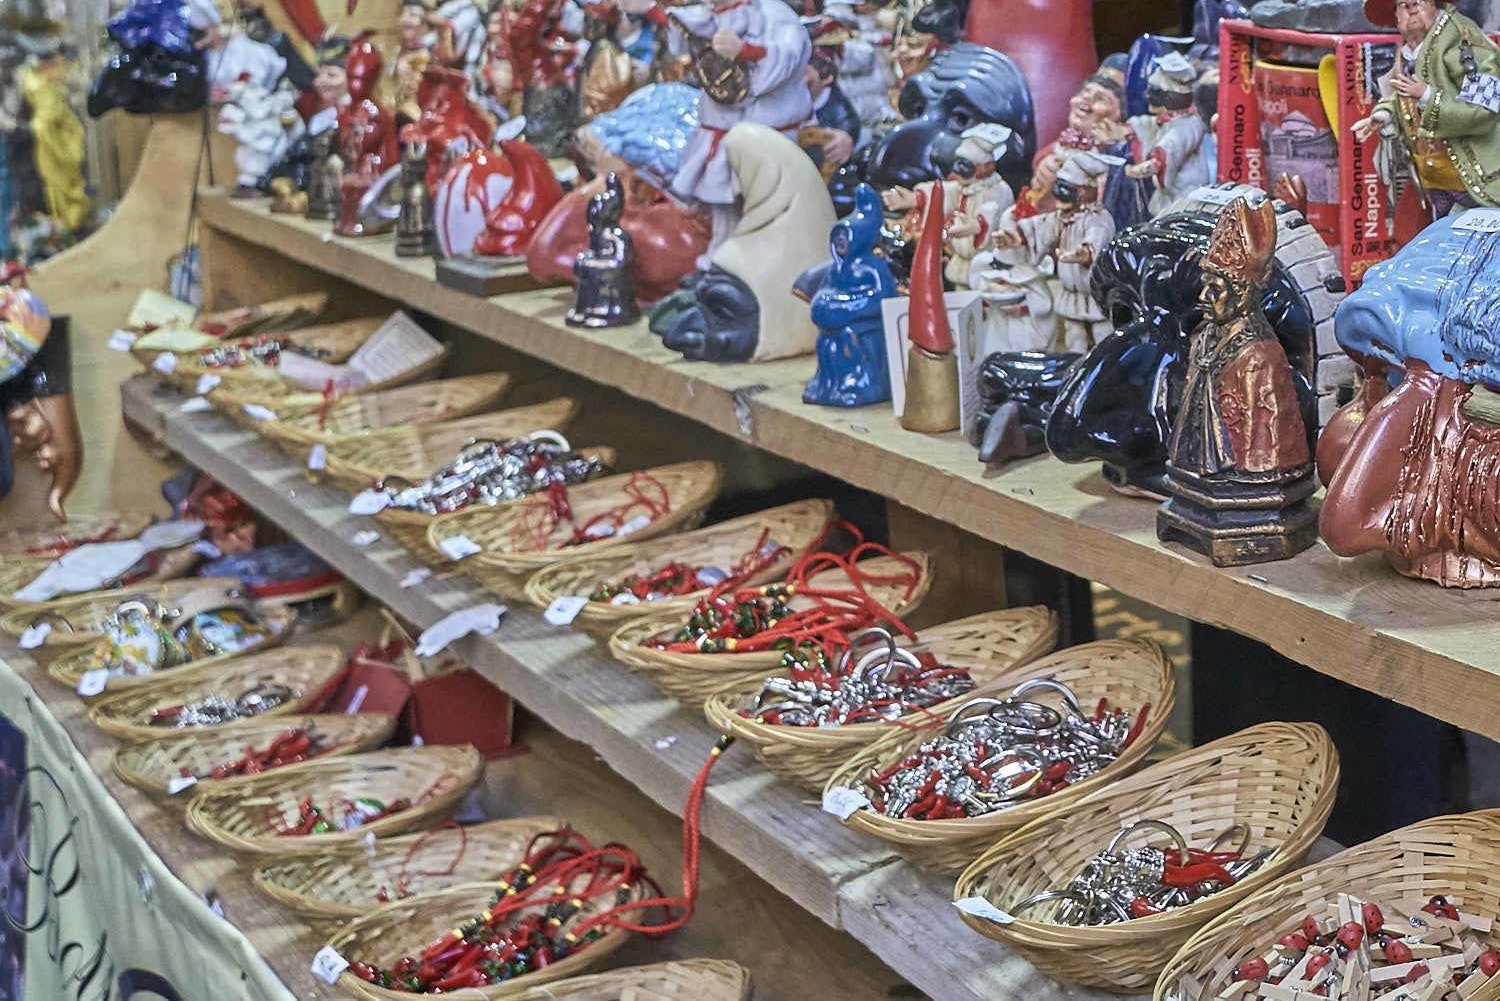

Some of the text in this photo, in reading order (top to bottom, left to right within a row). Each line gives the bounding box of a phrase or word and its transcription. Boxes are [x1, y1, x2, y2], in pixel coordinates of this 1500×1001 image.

[1229, 103, 1246, 181] Gennaro
[1246, 148, 1261, 188] apoli
[1351, 131, 1363, 256] San Gennar
[1364, 173, 1379, 238] Napoli
